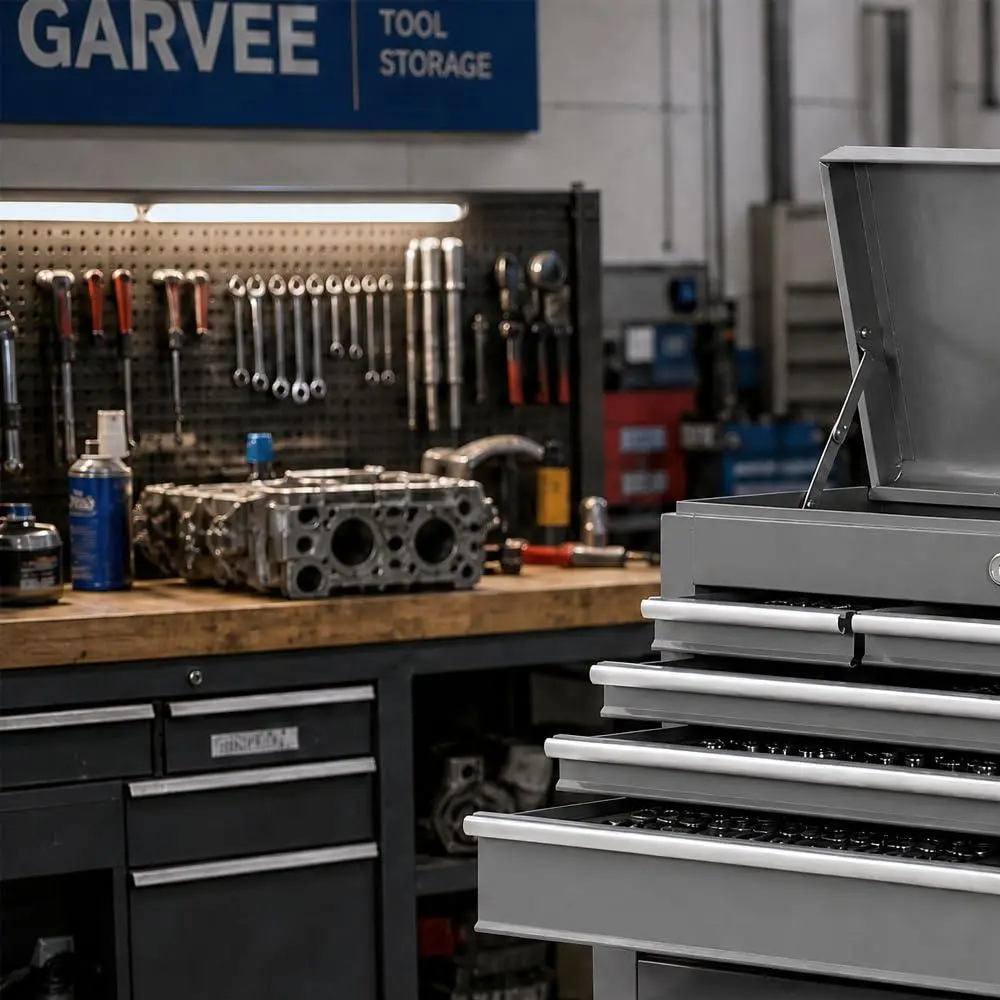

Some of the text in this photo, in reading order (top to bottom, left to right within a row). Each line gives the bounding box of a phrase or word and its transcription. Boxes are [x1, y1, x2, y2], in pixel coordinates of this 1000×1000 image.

[18, 0, 319, 76] GARVEE
[379, 8, 448, 39] TOOL
[379, 48, 493, 80] STORAGE
